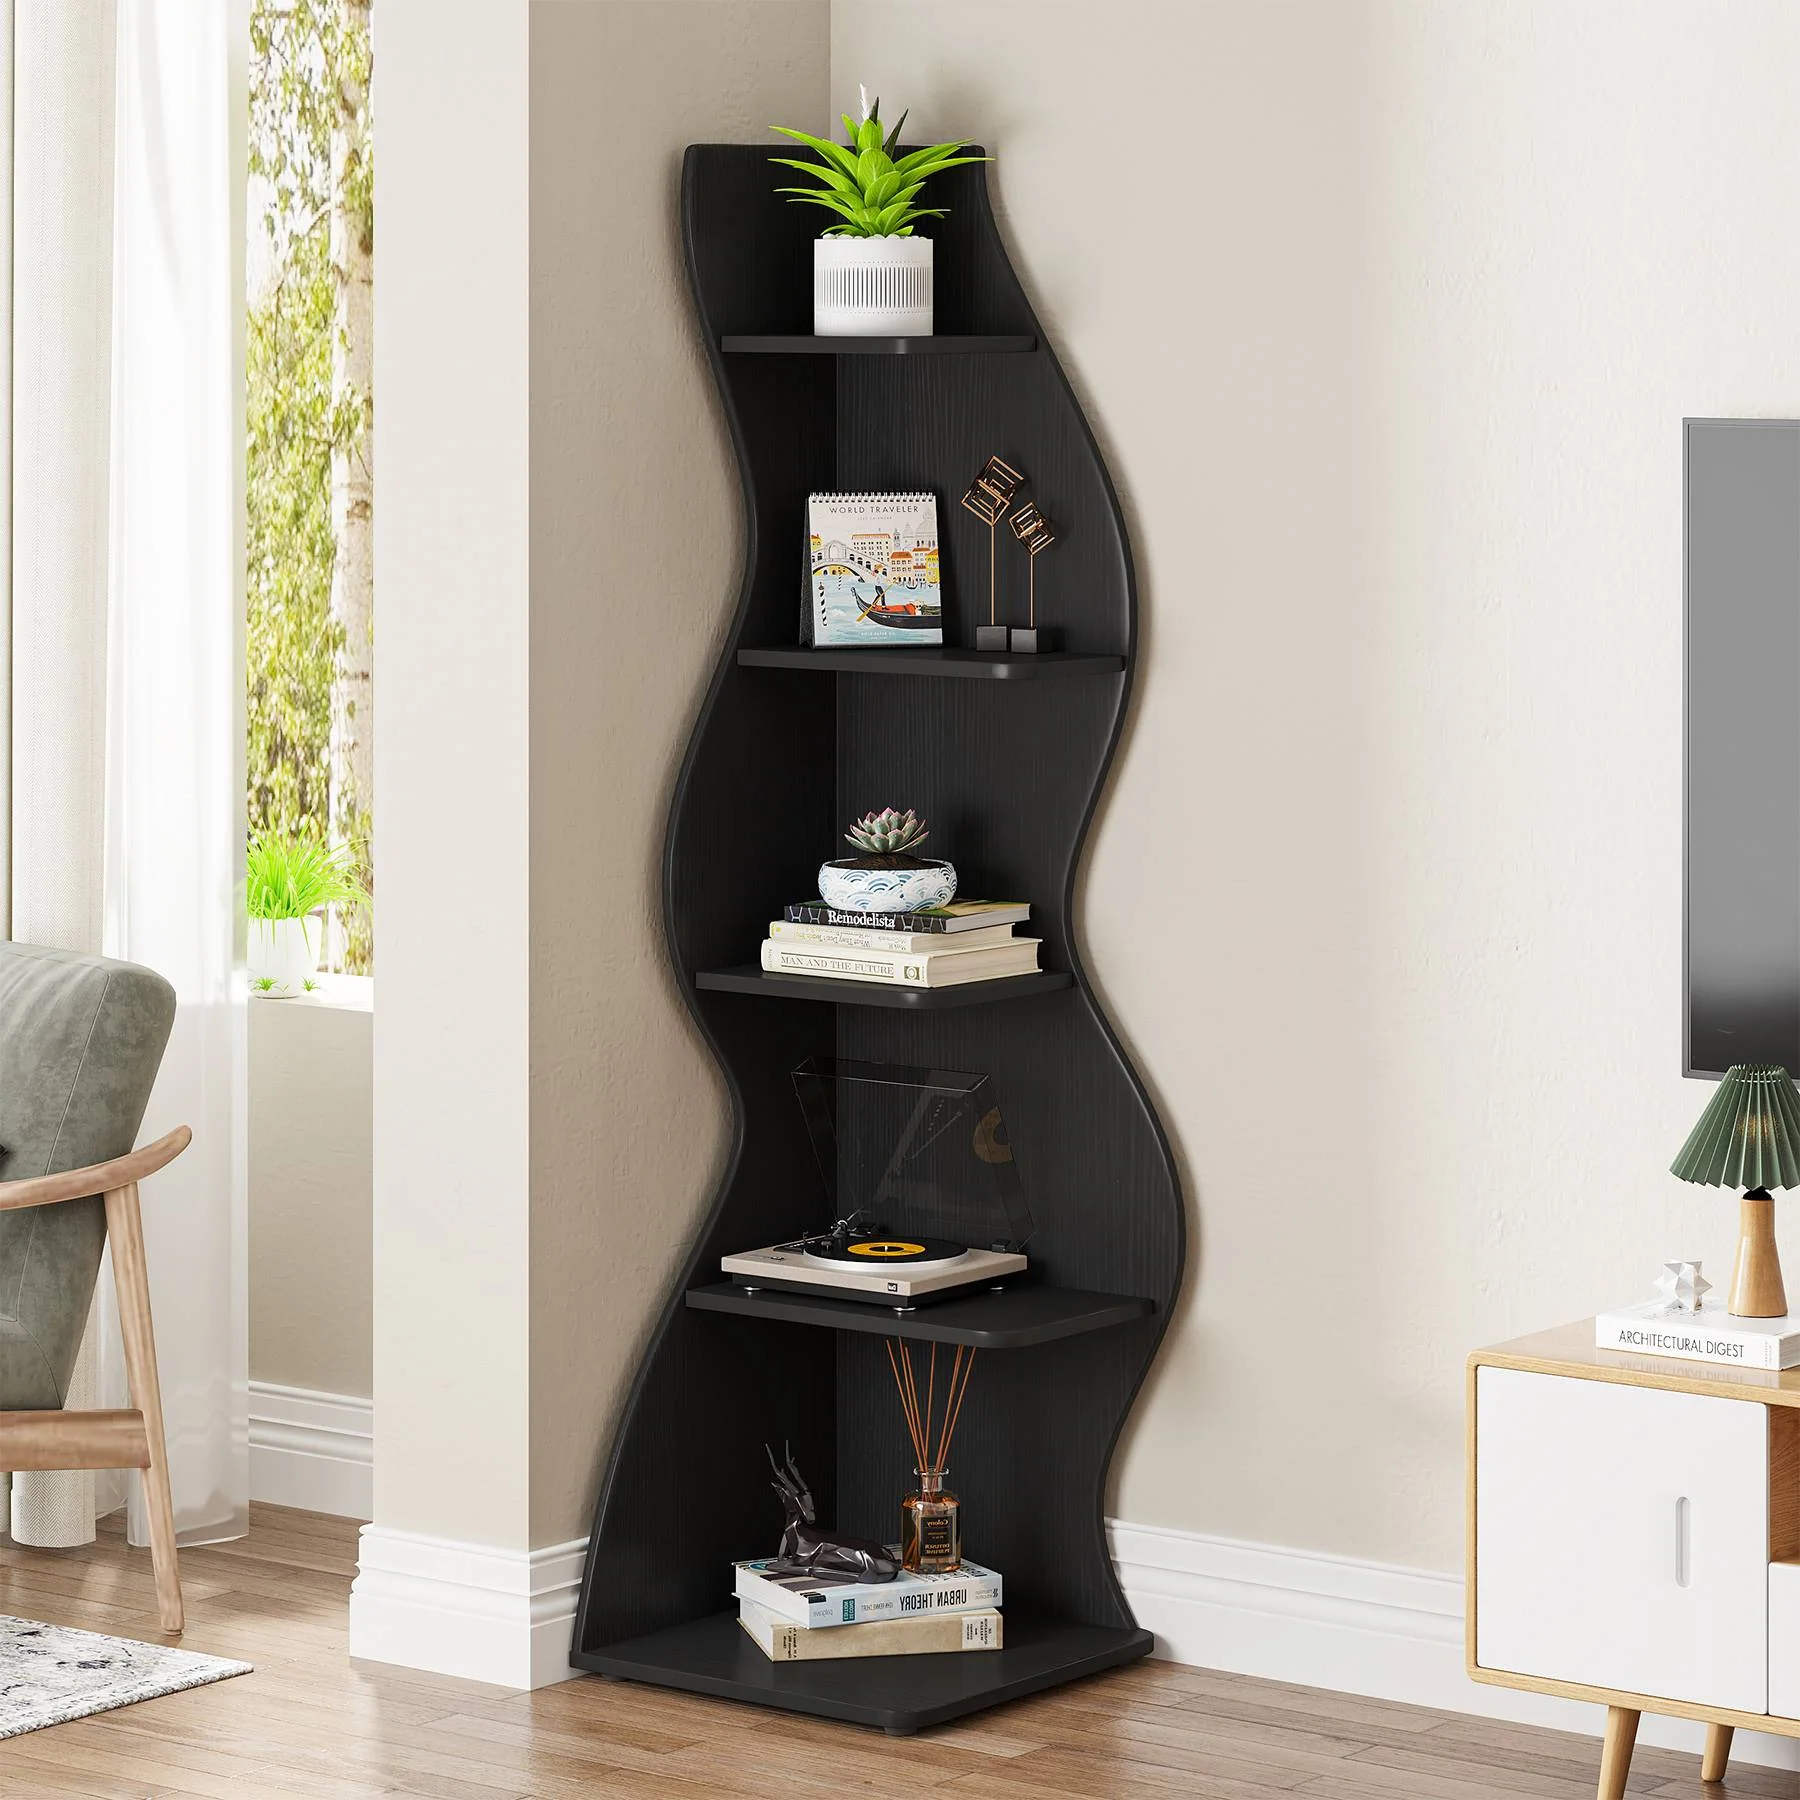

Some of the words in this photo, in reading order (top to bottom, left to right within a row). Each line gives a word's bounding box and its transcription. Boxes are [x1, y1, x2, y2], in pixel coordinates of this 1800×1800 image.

[828, 910, 896, 928] Remodelista
[781, 956, 803, 966] MAN
[808, 959, 828, 968] AND
[831, 961, 851, 970] THE
[855, 964, 894, 975] FUTURE
[1619, 1330, 1703, 1353] ARCHITECTURAL
[1706, 1341, 1744, 1358] DIGEST
